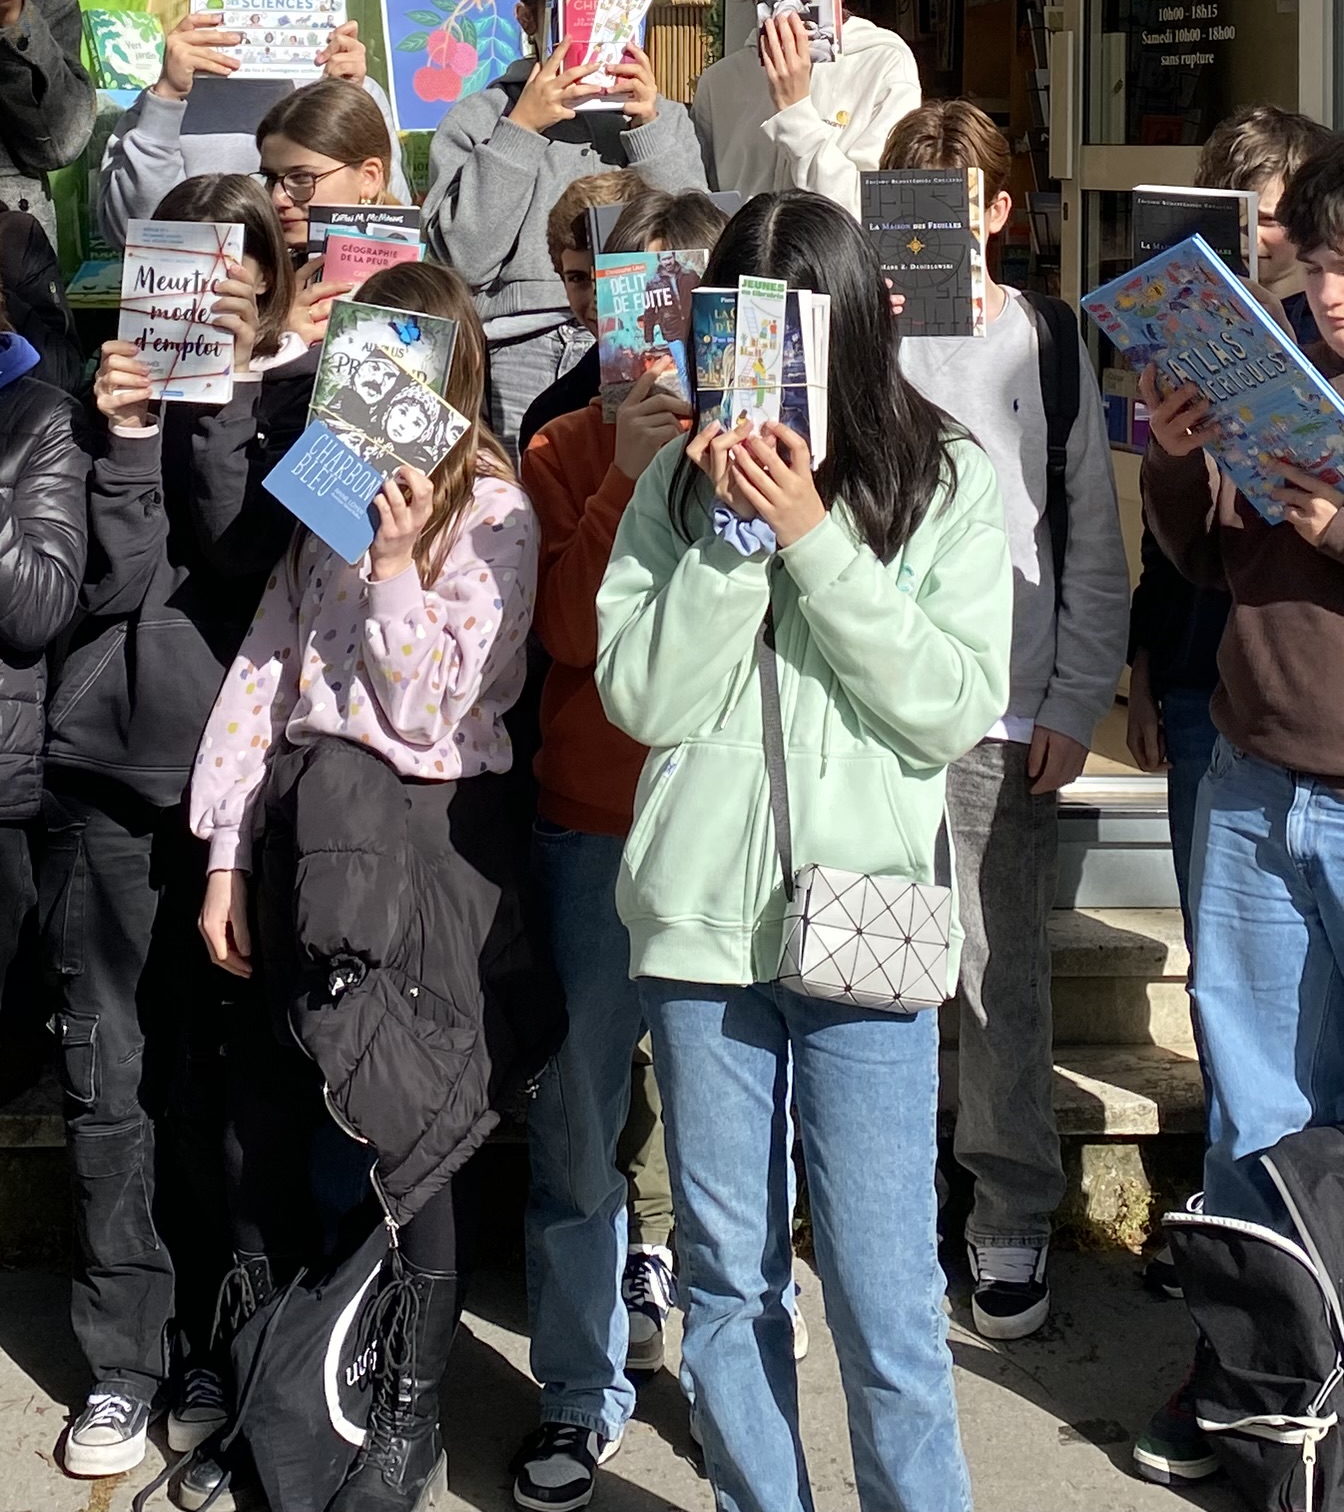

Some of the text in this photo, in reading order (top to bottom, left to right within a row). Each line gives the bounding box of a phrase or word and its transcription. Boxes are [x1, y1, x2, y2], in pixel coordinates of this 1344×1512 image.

[1159, 6, 1184, 21] 10h00
[1191, 4, 1218, 19] 18h15
[1142, 29, 1172, 44] Samedi
[1175, 27, 1201, 42] 10h00
[1209, 26, 1235, 40] 18h00
[1161, 52, 1214, 69] sans rupture
[341, 253, 389, 266] DE LA PEUR
[342, 244, 398, 259] GÉOGRAPHIE
[610, 273, 647, 296] DÉLIT
[742, 279, 784, 292] JEUNES
[613, 287, 673, 314] DE FUITE
[151, 298, 210, 323] mode
[291, 452, 338, 498] BLEU
[309, 434, 382, 501] CHARBON
